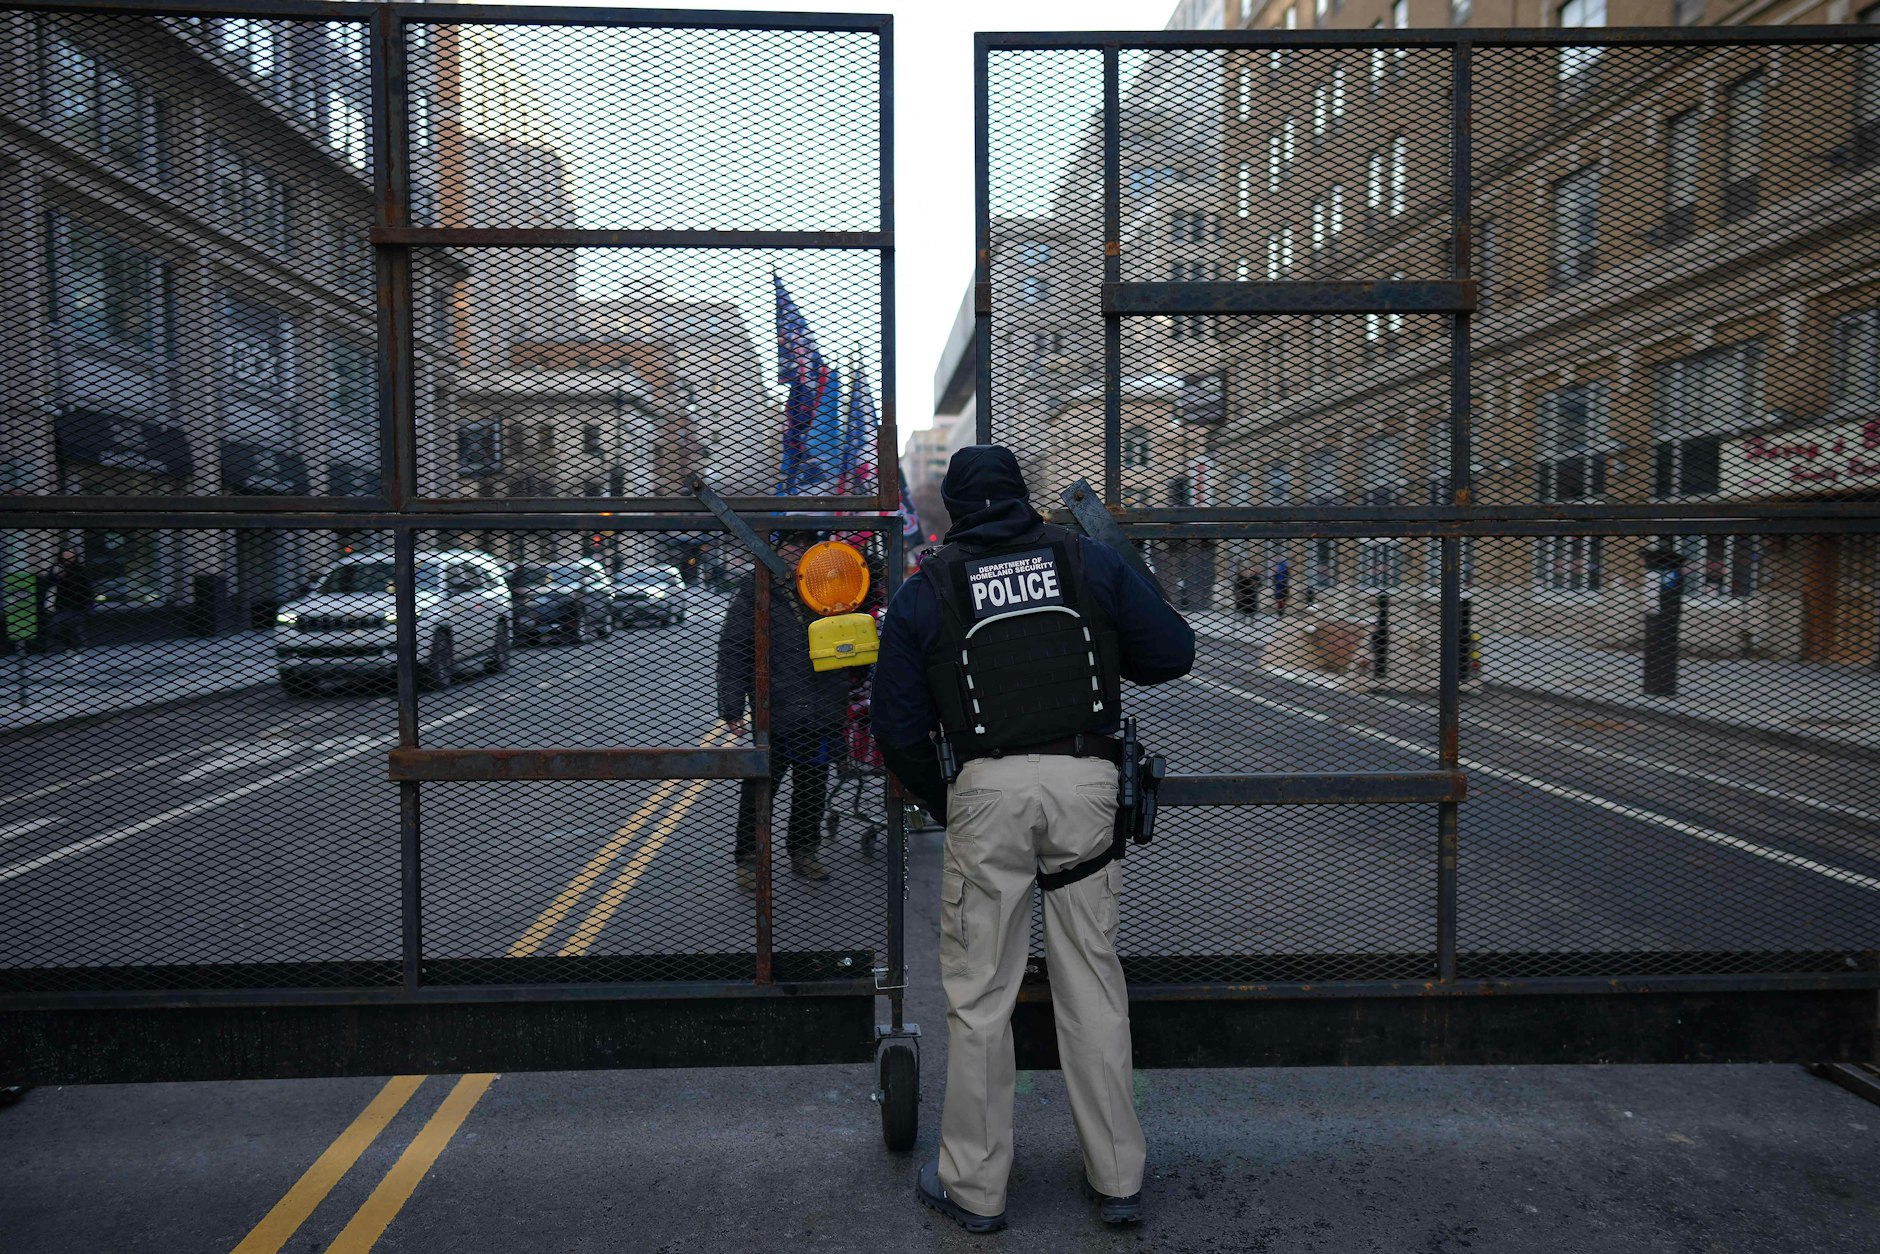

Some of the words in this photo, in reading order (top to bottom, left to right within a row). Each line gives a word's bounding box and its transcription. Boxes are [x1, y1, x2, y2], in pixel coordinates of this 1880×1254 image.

[970, 568, 1013, 582] HOMELAND
[1015, 561, 1054, 574] SECURITY
[978, 559, 1030, 574] DEPARTMENT
[1031, 556, 1043, 564] OF
[972, 570, 1060, 610] POLICE
